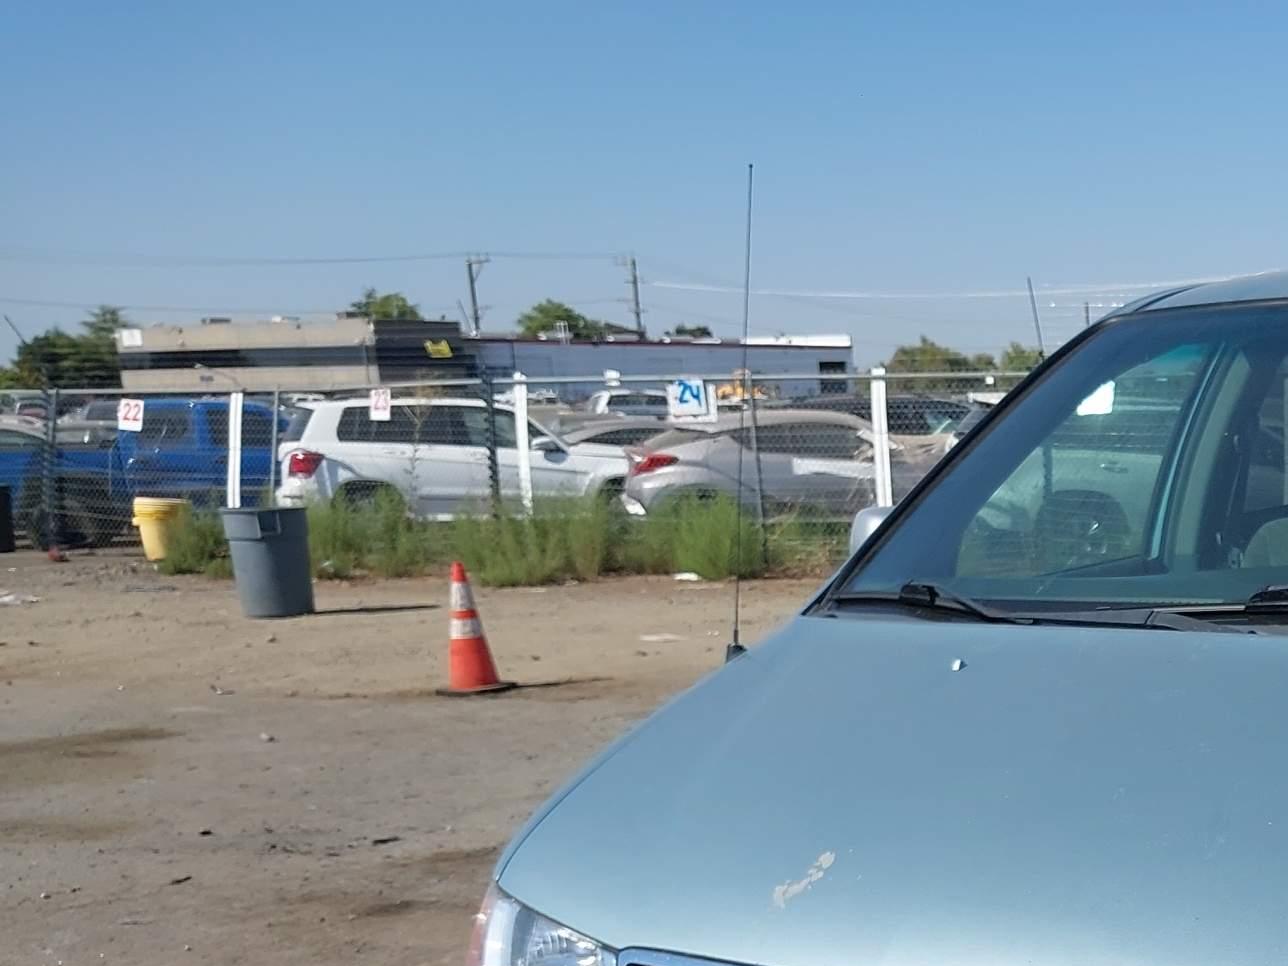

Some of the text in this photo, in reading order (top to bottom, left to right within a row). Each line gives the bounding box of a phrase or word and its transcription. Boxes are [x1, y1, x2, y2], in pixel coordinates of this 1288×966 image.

[374, 390, 389, 410] 23
[678, 380, 702, 407] 24
[122, 402, 141, 421] 22
